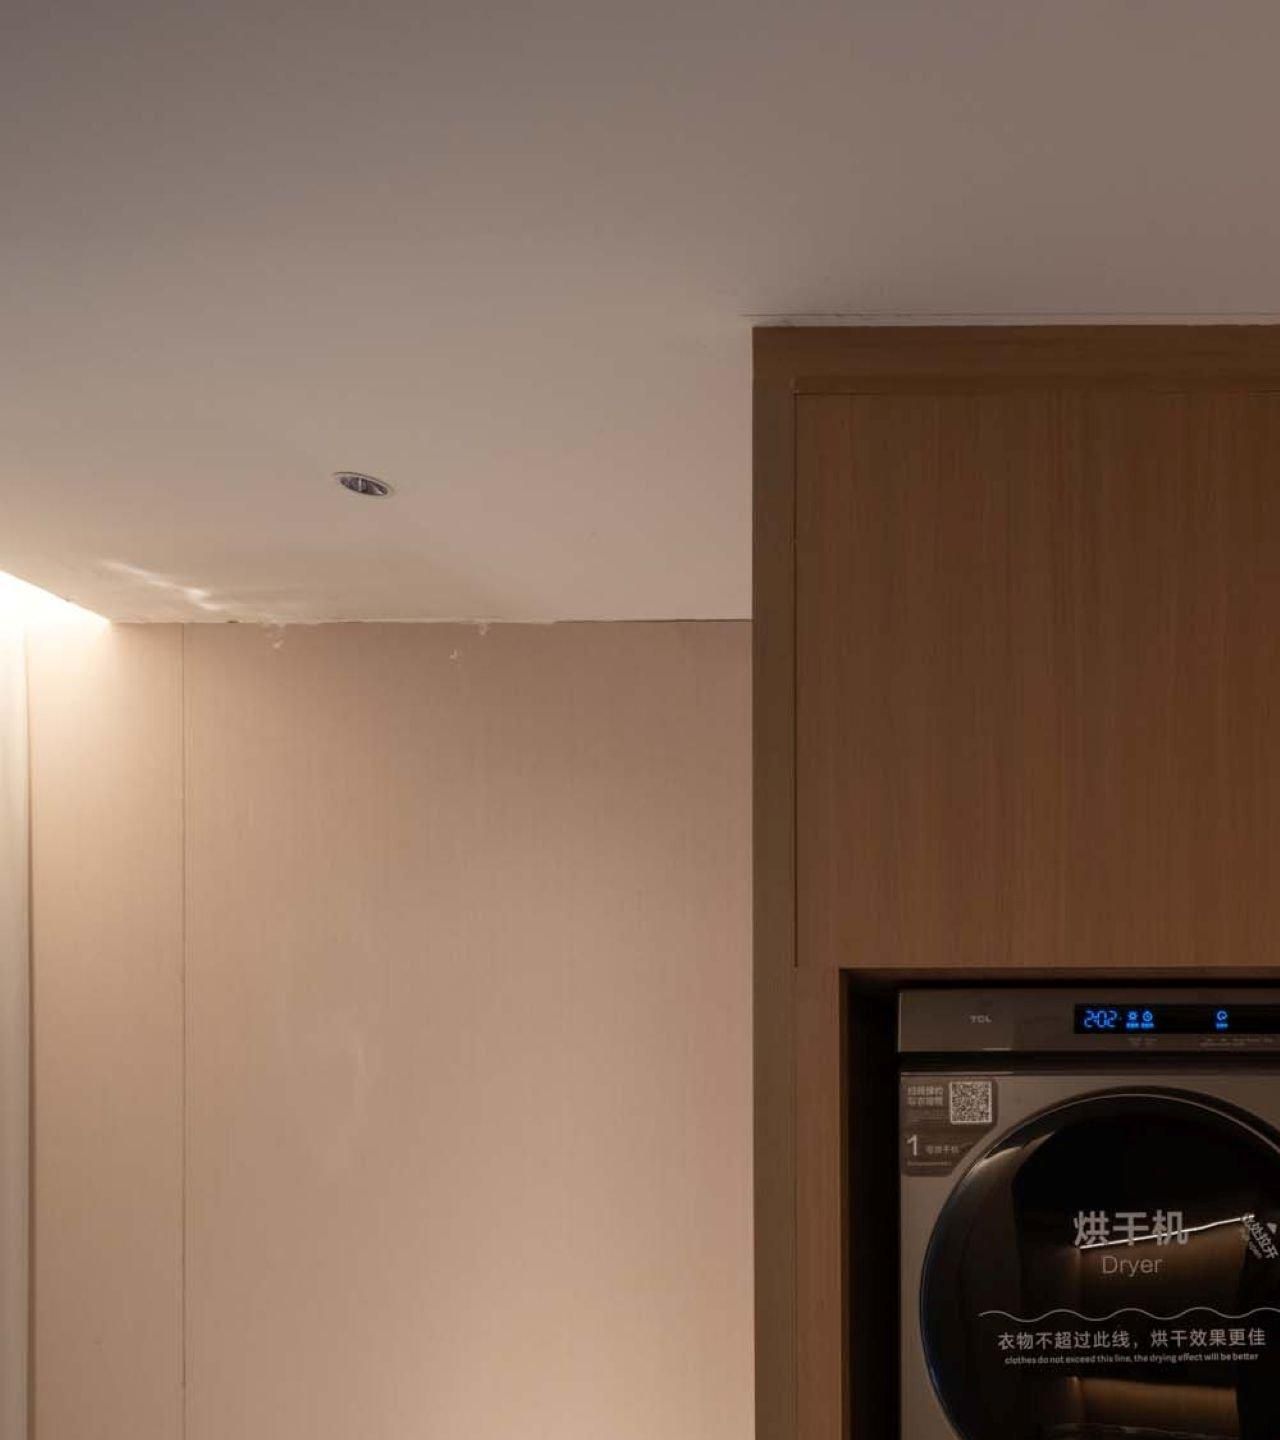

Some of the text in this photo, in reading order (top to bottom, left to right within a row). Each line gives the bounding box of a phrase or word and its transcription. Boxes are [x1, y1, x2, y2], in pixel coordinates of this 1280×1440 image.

[969, 1014, 992, 1023] TCL
[906, 1134, 919, 1156] 1
[1073, 1209, 1189, 1247] 烘干机
[1103, 1254, 1163, 1278] Dryer
[998, 1329, 1265, 1349] 衣物不超过此线，烘干效果更佳
